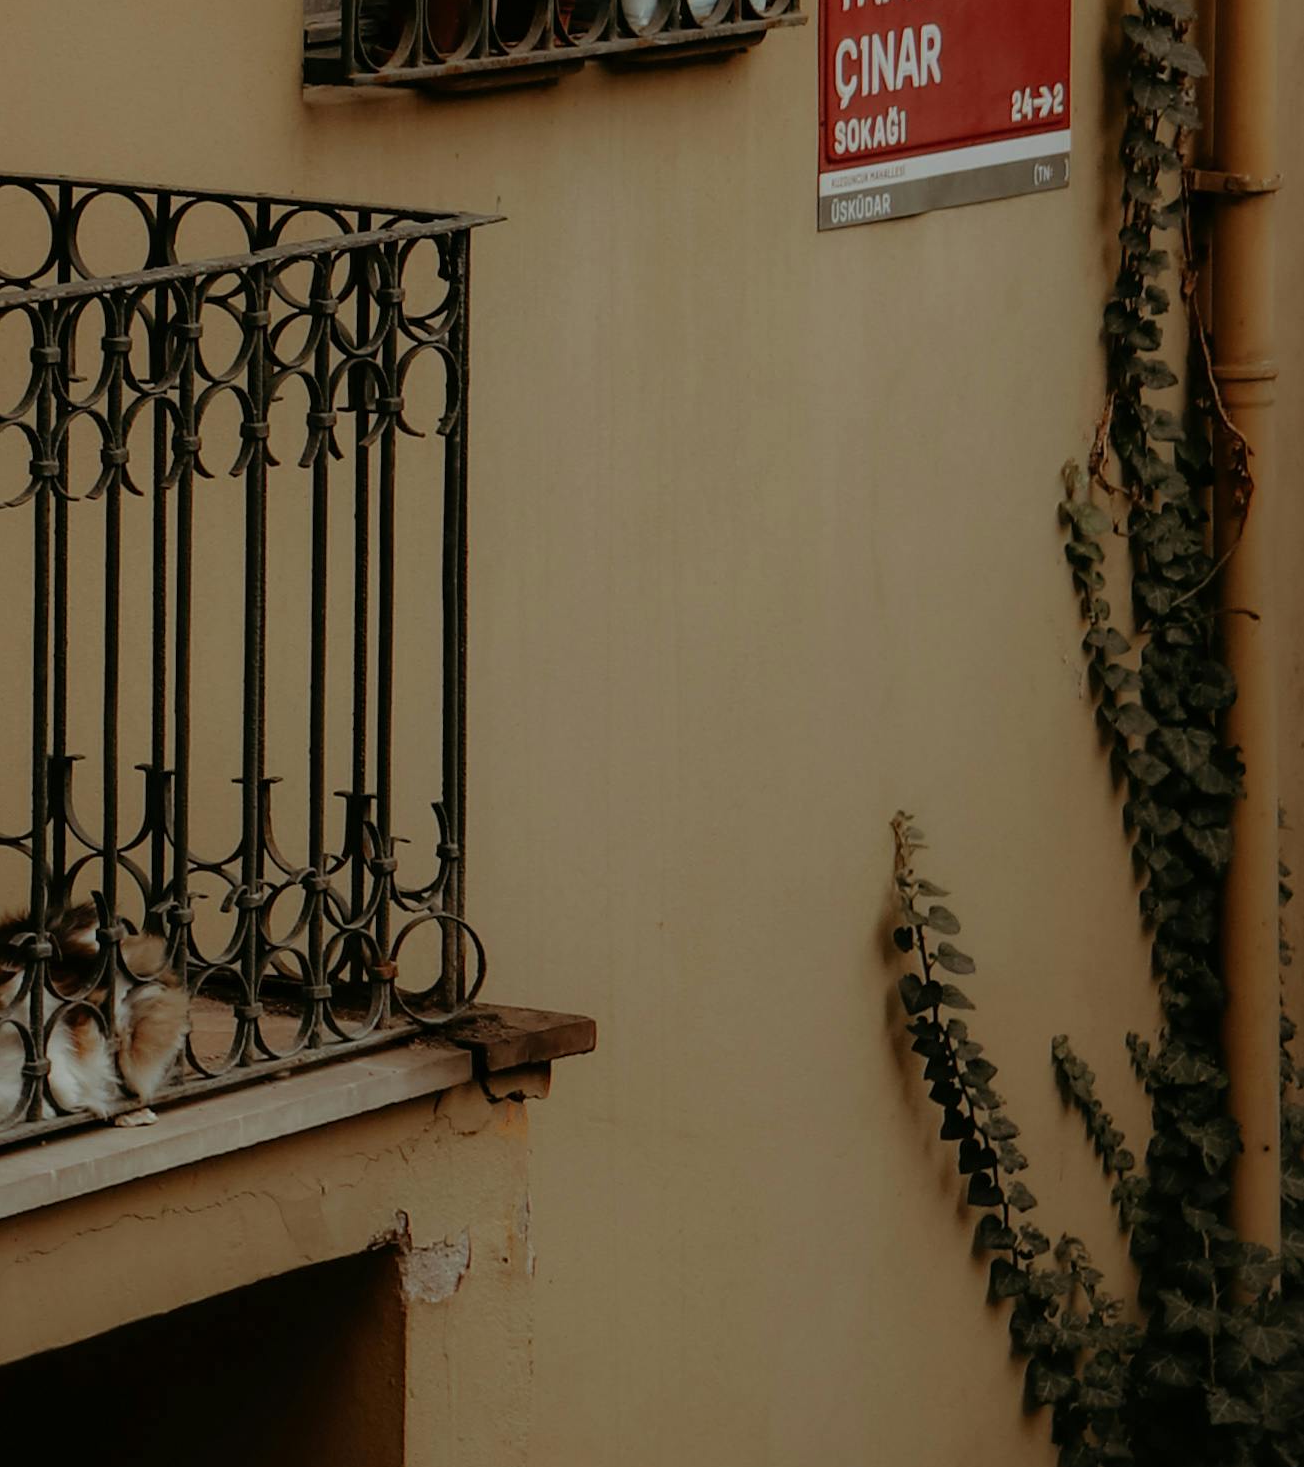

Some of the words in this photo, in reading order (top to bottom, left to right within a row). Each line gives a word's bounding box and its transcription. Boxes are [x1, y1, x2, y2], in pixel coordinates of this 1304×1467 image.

[834, 23, 942, 110] ÇINAR
[834, 105, 907, 155] SOKAĞI
[831, 193, 892, 224] ÜSKÜDAR
